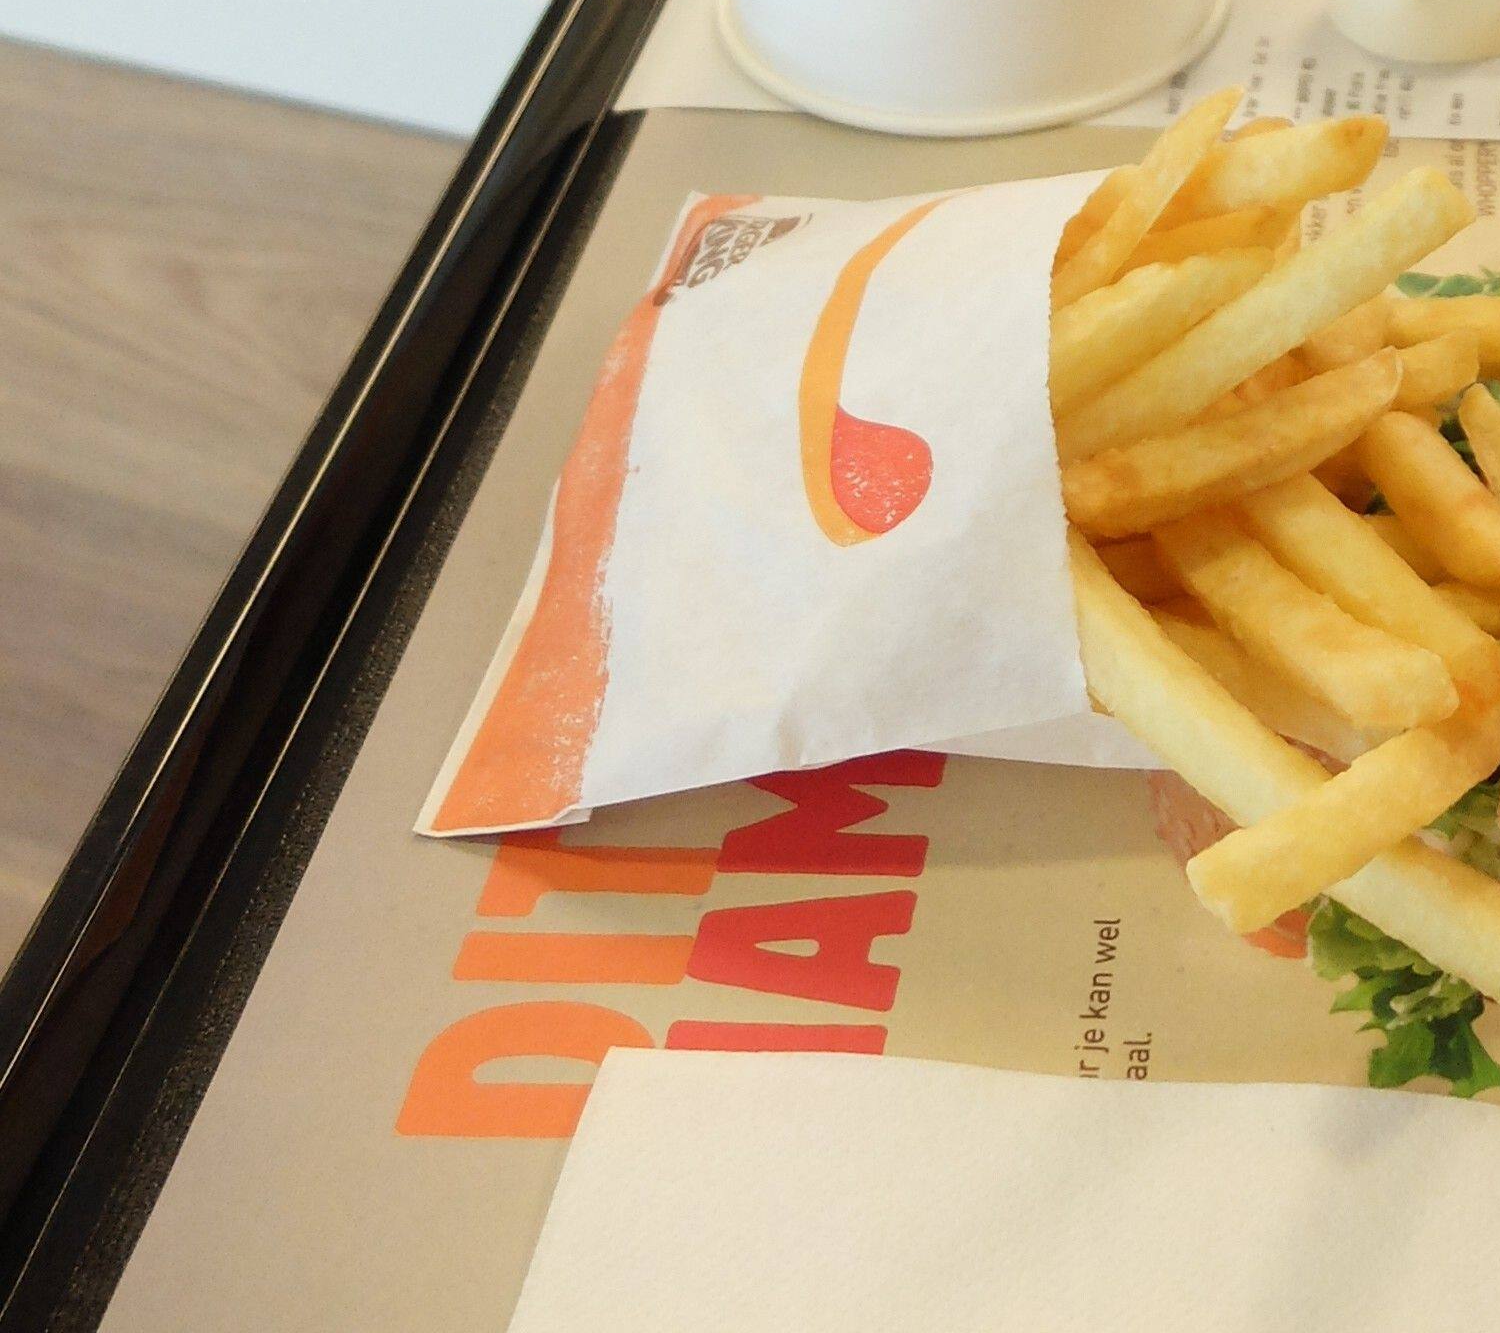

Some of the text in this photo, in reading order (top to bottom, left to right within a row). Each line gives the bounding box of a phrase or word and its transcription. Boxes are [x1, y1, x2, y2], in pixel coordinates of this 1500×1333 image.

[1093, 918, 1122, 964] wel
[1078, 972, 1114, 1020] kan
[1073, 1028, 1110, 1054] je
